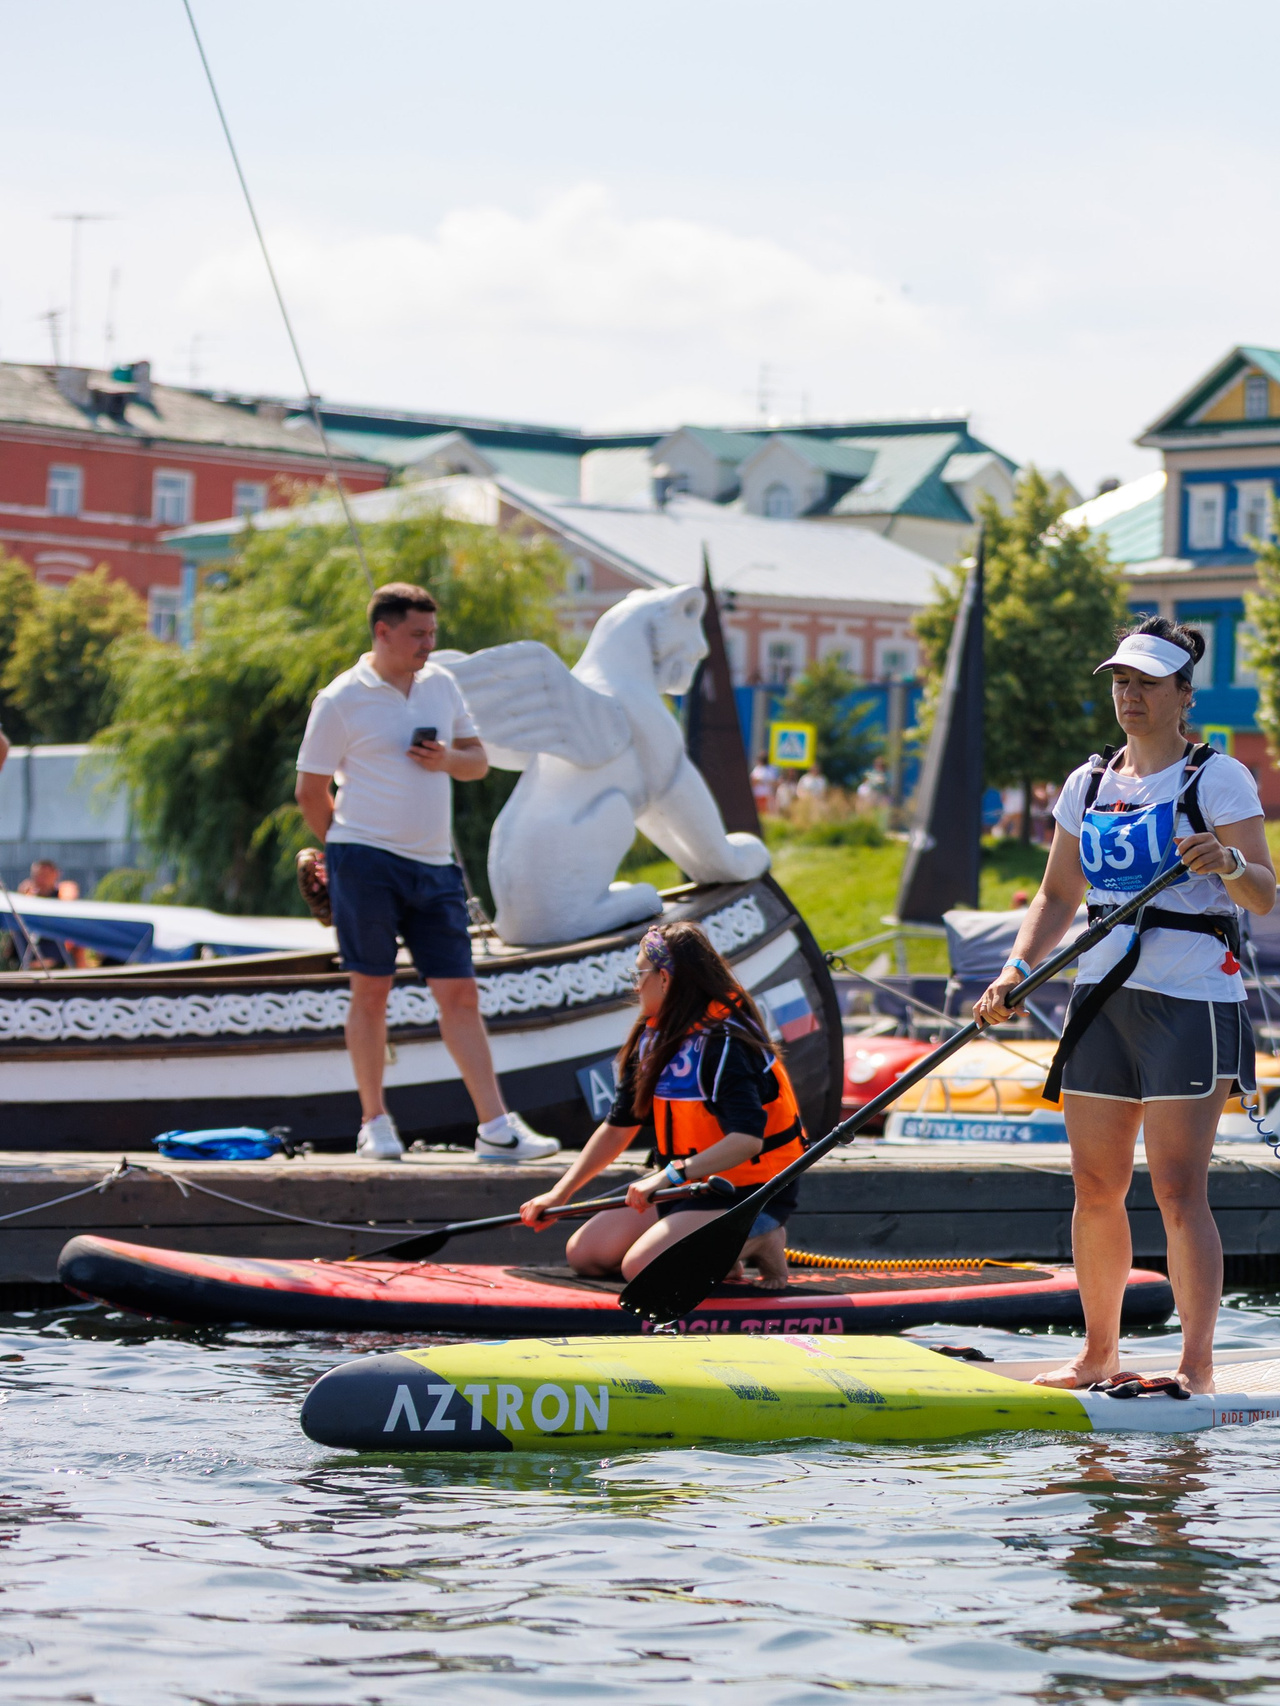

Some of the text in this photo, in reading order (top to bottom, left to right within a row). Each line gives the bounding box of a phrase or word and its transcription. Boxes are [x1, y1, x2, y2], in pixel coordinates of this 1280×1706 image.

[1080, 813, 1162, 873] 031
[904, 1121, 1032, 1140] SUNLIGHT 4
[382, 1383, 609, 1432] AZTRON
[1221, 1411, 1244, 1424] RIDE
